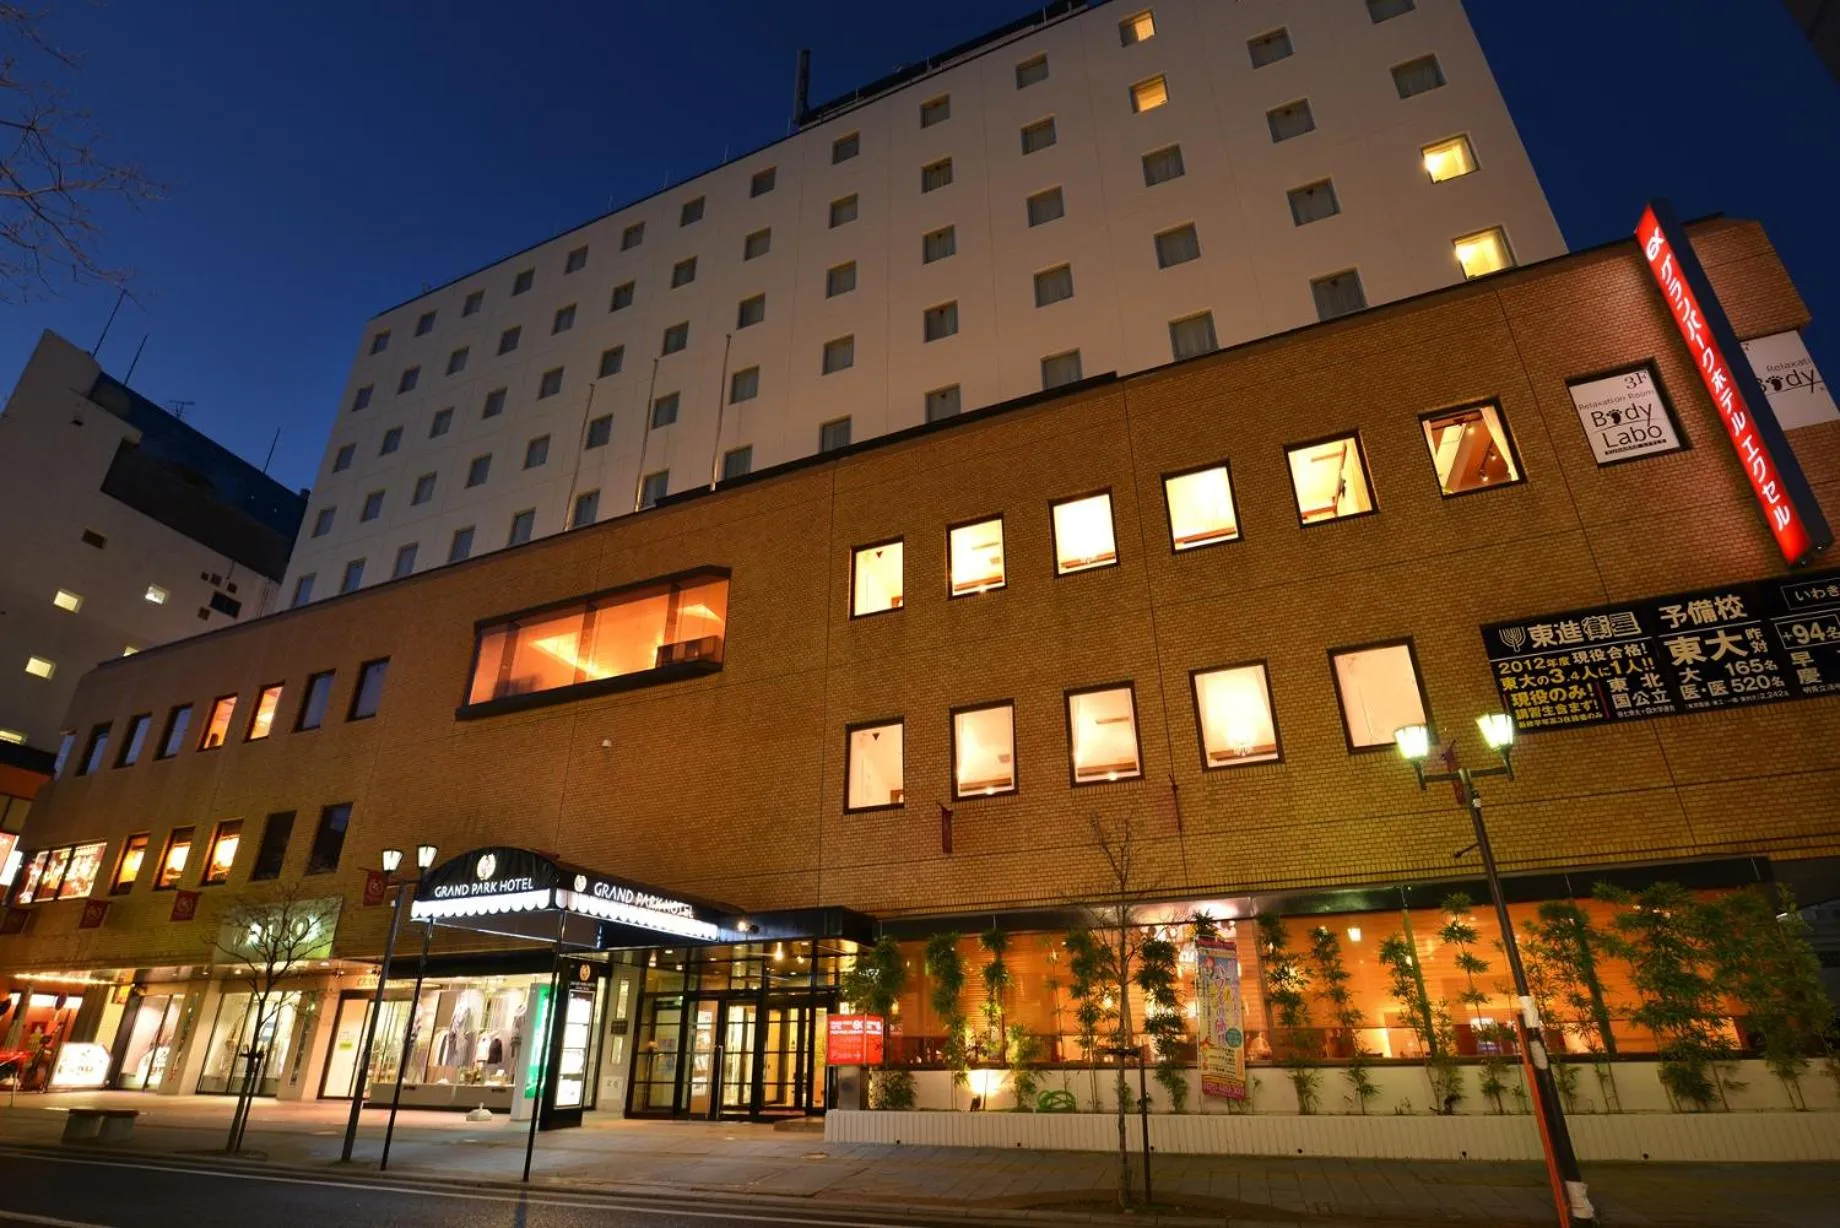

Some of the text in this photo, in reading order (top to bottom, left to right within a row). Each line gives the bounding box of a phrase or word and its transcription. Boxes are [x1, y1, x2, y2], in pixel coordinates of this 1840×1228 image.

[1602, 425, 1662, 448] Labo
[1658, 593, 1748, 629] 予備校
[1664, 629, 1749, 666] 東大
[434, 877, 534, 898] GRAND PARK HOTEL
[594, 882, 634, 904] GRAND
